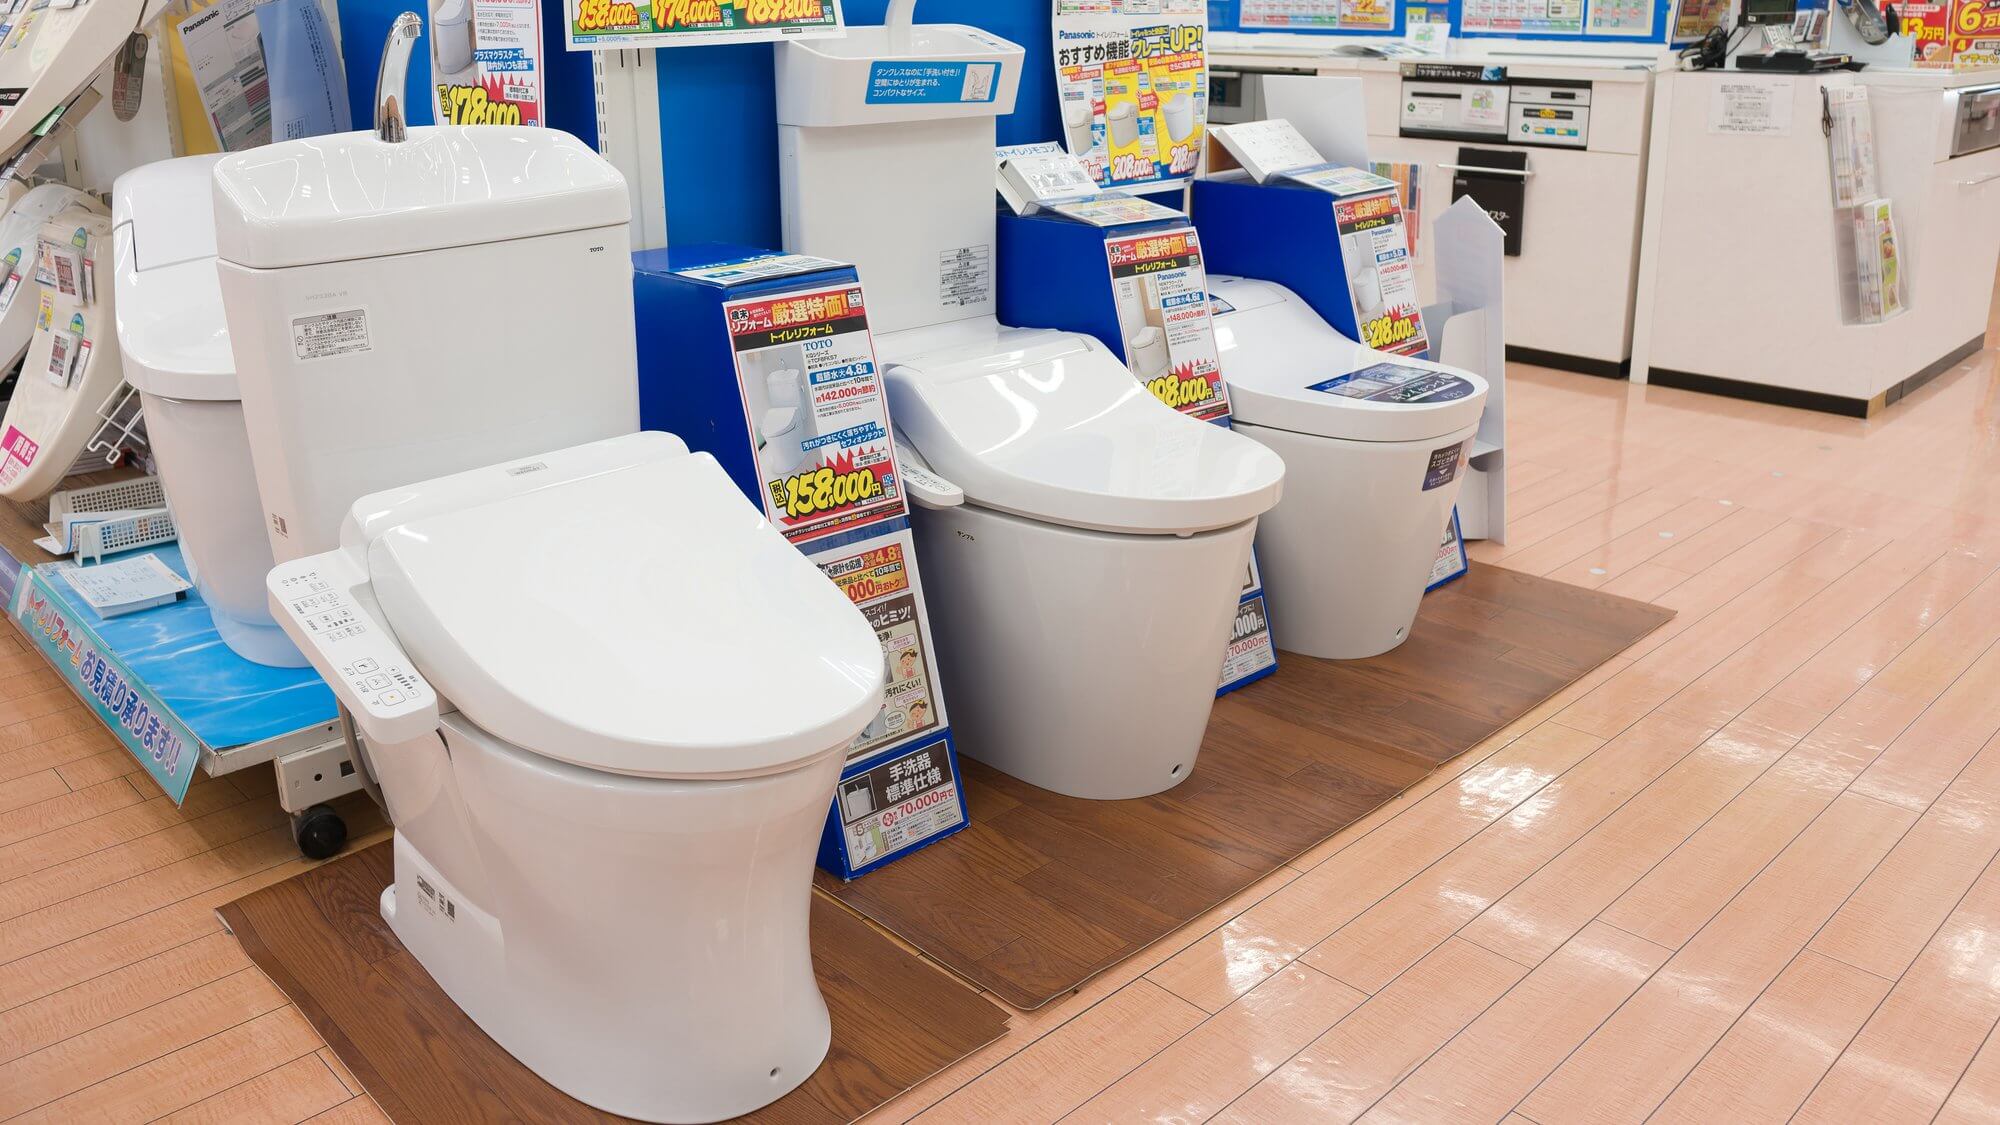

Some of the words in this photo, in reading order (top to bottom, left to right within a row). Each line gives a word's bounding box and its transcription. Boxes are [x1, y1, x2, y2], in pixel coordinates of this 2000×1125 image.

[183, 10, 220, 35] Panasonic
[1959, 2, 2000, 32] 6万
[1059, 30, 1096, 40] Panasonic
[1059, 40, 1130, 66] おすすめ機能
[1111, 251, 1137, 264] リフォーム
[1135, 235, 1188, 260] 厳選特価!
[1135, 260, 1178, 274] トイレリフォーム
[1158, 270, 1187, 281] Panasonic
[771, 293, 849, 326] 厳選特価!
[732, 318, 773, 333] リフォーム
[770, 324, 834, 344] トイレリフォーム
[1370, 316, 1416, 349] 218,000円
[803, 339, 833, 351] TOTO
[802, 423, 876, 450] 汚れがつきにくく落ちやすい
[786, 468, 882, 518] 158,000円
[885, 678, 922, 699] 汚れにくい!
[80, 649, 183, 776] お見積り承ります!!
[889, 752, 931, 782] 手洗器
[885, 766, 942, 803] 標準仕様
[897, 788, 954, 818] 70,000円で
